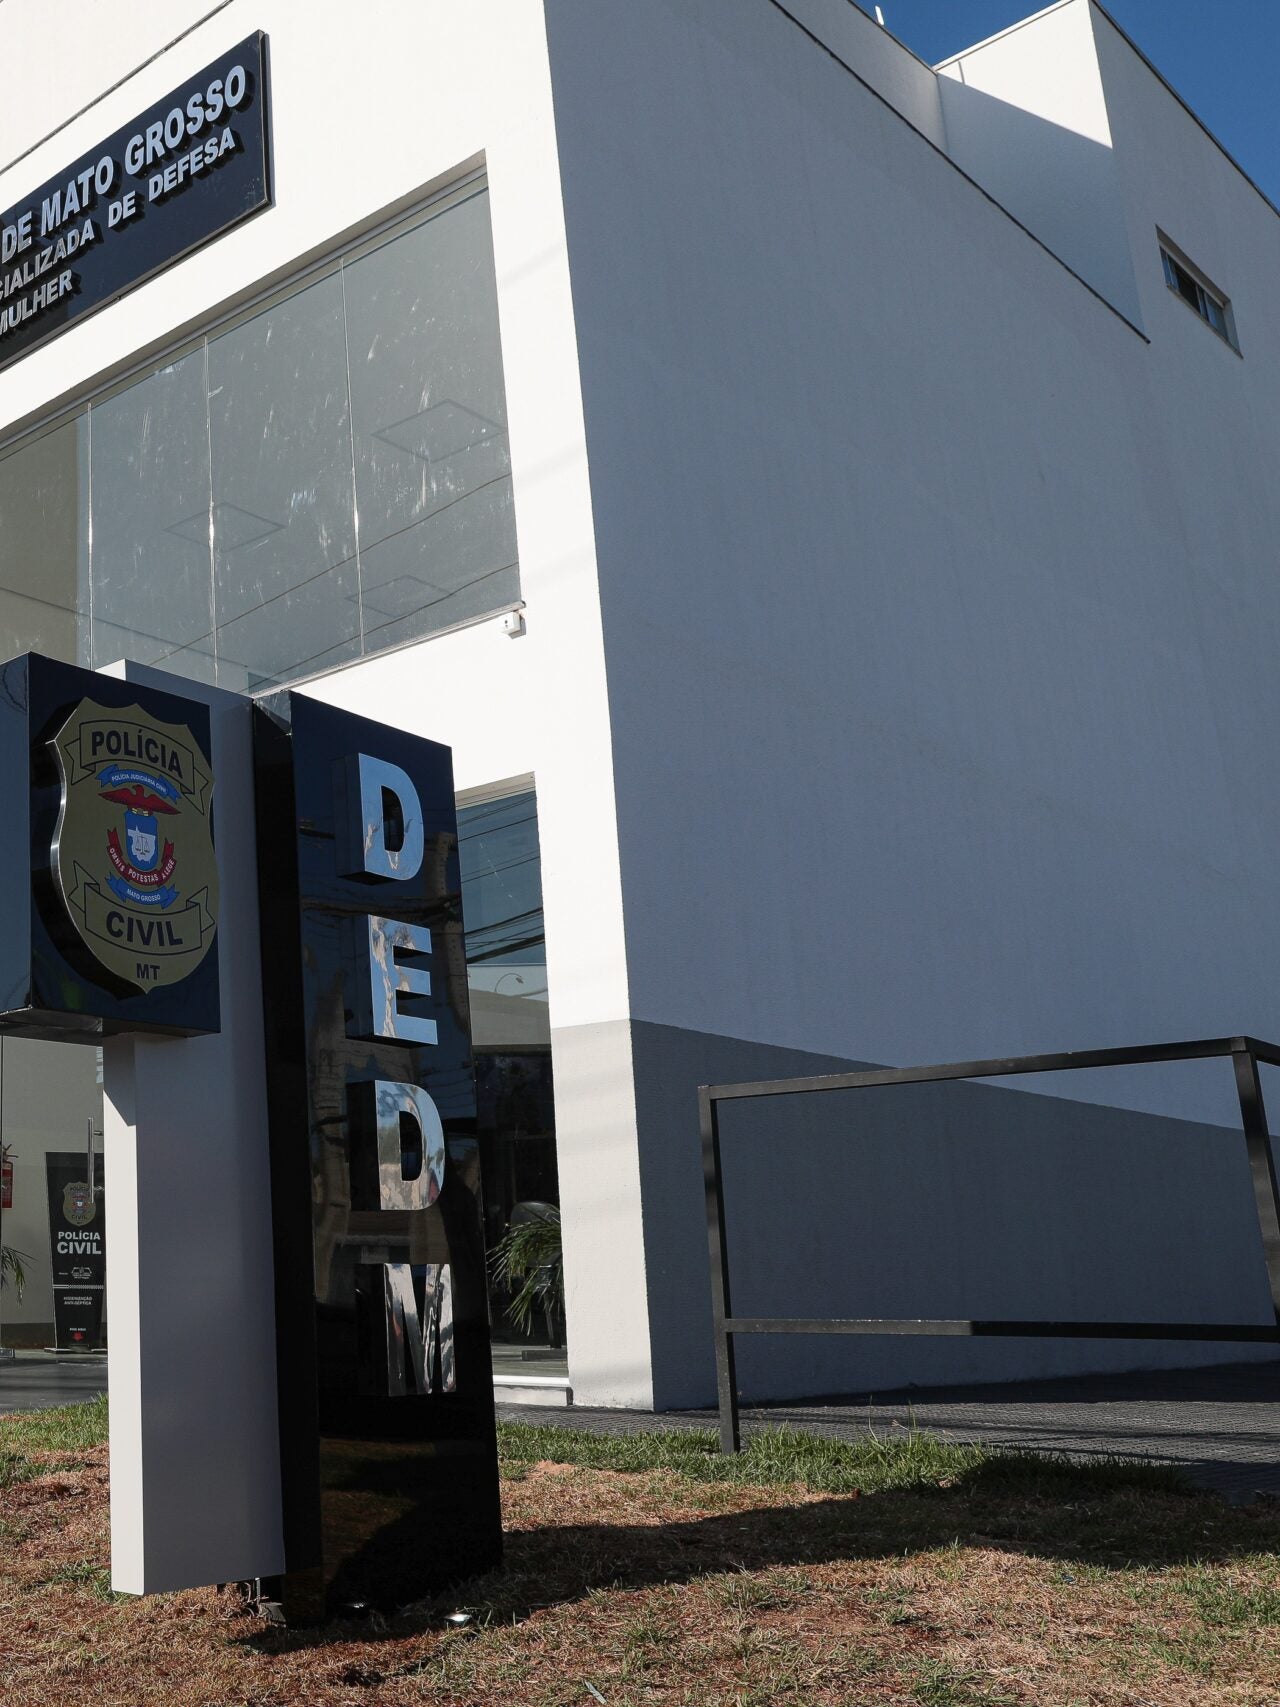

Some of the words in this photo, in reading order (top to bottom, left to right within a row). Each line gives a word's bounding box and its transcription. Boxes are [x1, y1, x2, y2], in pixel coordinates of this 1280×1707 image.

[1, 211, 33, 264] DE
[41, 157, 114, 237] MATO
[125, 65, 246, 175] GROSSO
[108, 191, 136, 228] DE
[149, 128, 236, 202] DEFESA
[92, 728, 183, 779] POLÍCIA
[109, 847, 126, 872] OMNIS
[128, 868, 159, 883] POTESTAS
[106, 911, 183, 946] CIVIL
[136, 962, 160, 981] MT
[57, 1241, 102, 1255] CIVIL
[58, 1230, 101, 1241] POLÍCIA
